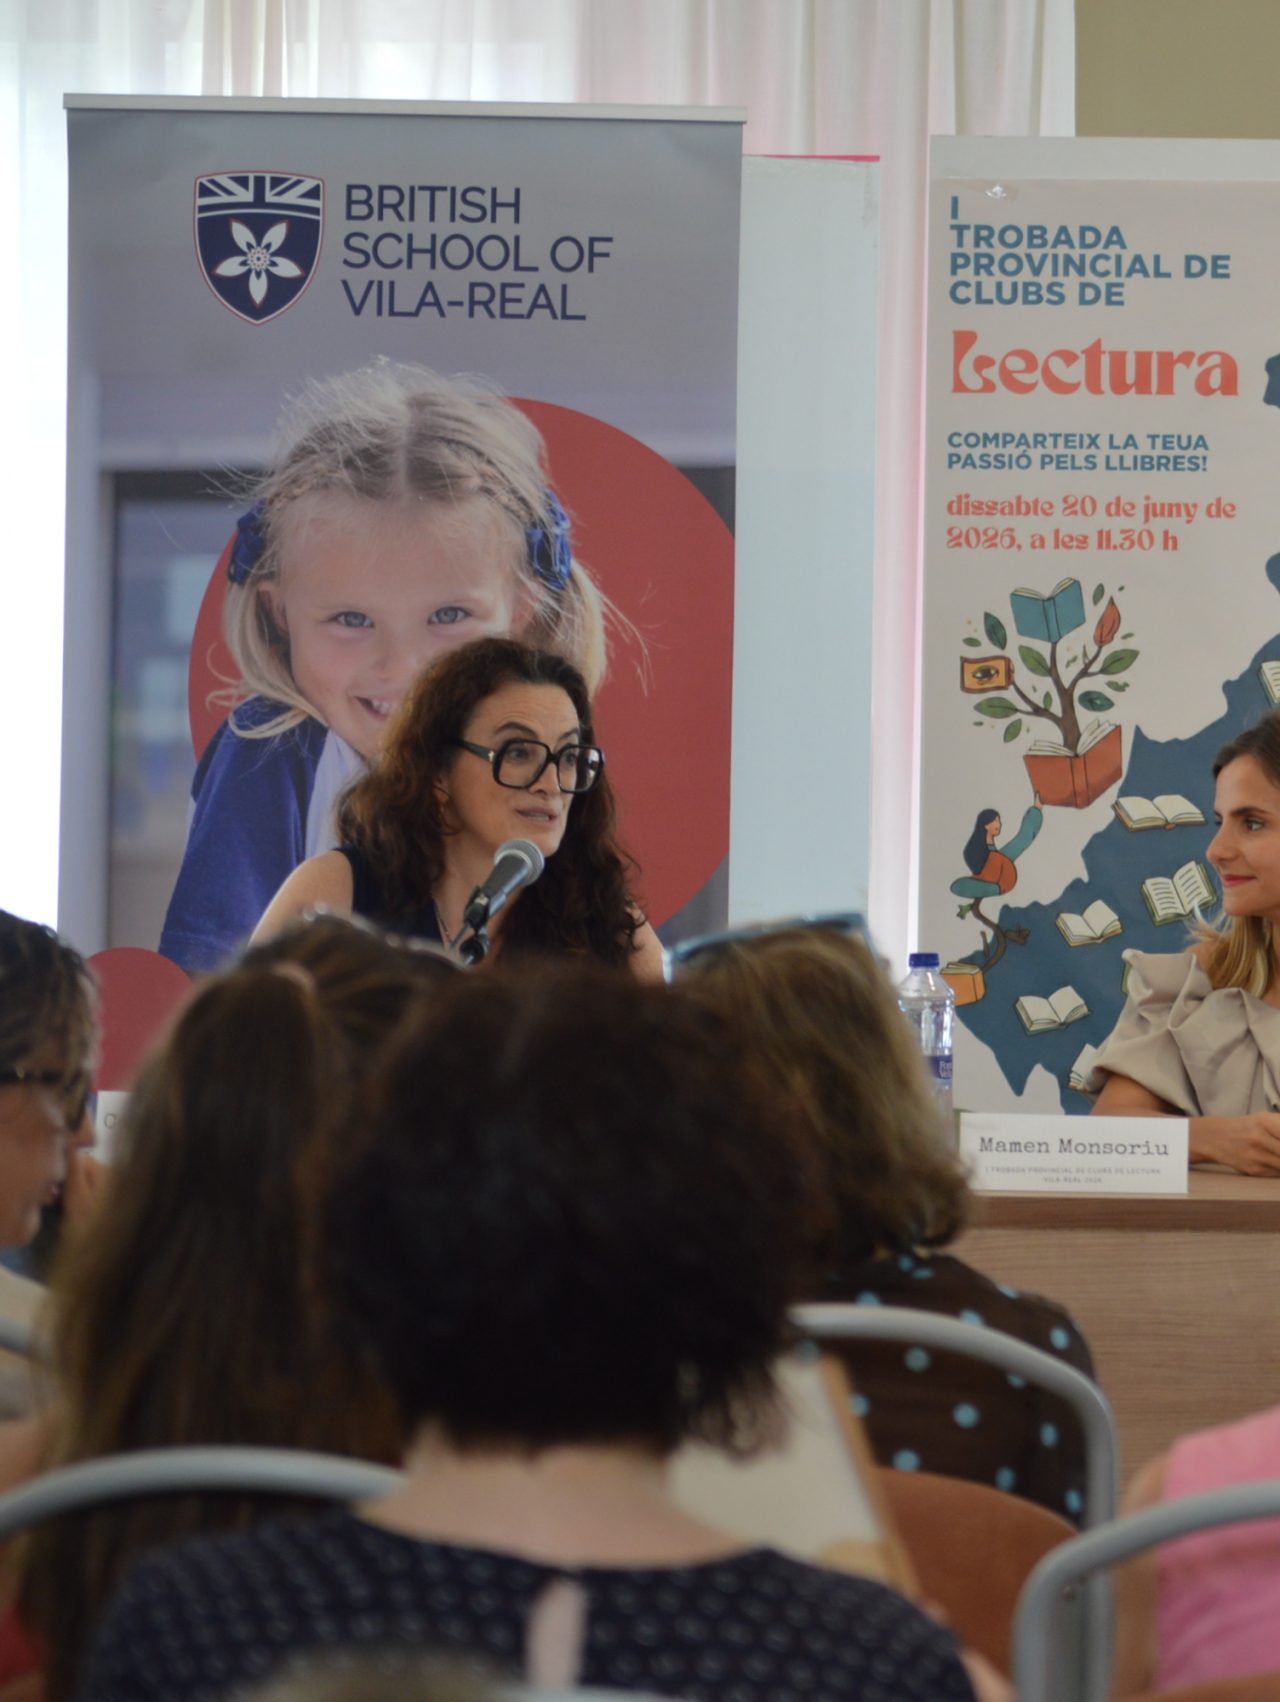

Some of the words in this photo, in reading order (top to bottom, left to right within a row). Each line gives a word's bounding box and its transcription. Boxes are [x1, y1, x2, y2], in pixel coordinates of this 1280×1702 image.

[344, 184, 521, 224] BRITISH
[950, 196, 959, 220] I
[950, 223, 1127, 250] TROBADA
[342, 231, 539, 272] SCHOOL
[549, 235, 614, 273] OF
[950, 252, 1172, 279] PROVINCIAL
[1183, 254, 1231, 279] DE
[341, 279, 586, 321] VILA-REAL
[949, 280, 1066, 306] CLUBS
[1078, 282, 1125, 306] DE
[951, 330, 1239, 397] Lectura
[947, 432, 1101, 450] COMPARTEIX
[1108, 433, 1139, 450] LA
[1146, 434, 1209, 451] TEUA
[947, 450, 1032, 471] PASSIÓ
[1040, 454, 1098, 471] PELS
[1104, 454, 1208, 472] LLIBRES!
[946, 493, 1055, 517] dissabte
[1062, 494, 1097, 517] 20
[1104, 496, 1137, 518] de
[1143, 494, 1199, 525] juny
[1205, 496, 1237, 519] de
[946, 526, 1023, 553] 2026,
[1030, 531, 1046, 550] a
[1053, 528, 1090, 550] les
[1096, 528, 1155, 552] 11.30
[1162, 529, 1179, 552] h
[979, 1137, 1050, 1154] Mamen
[1059, 1137, 1169, 1156] Monsoriu
